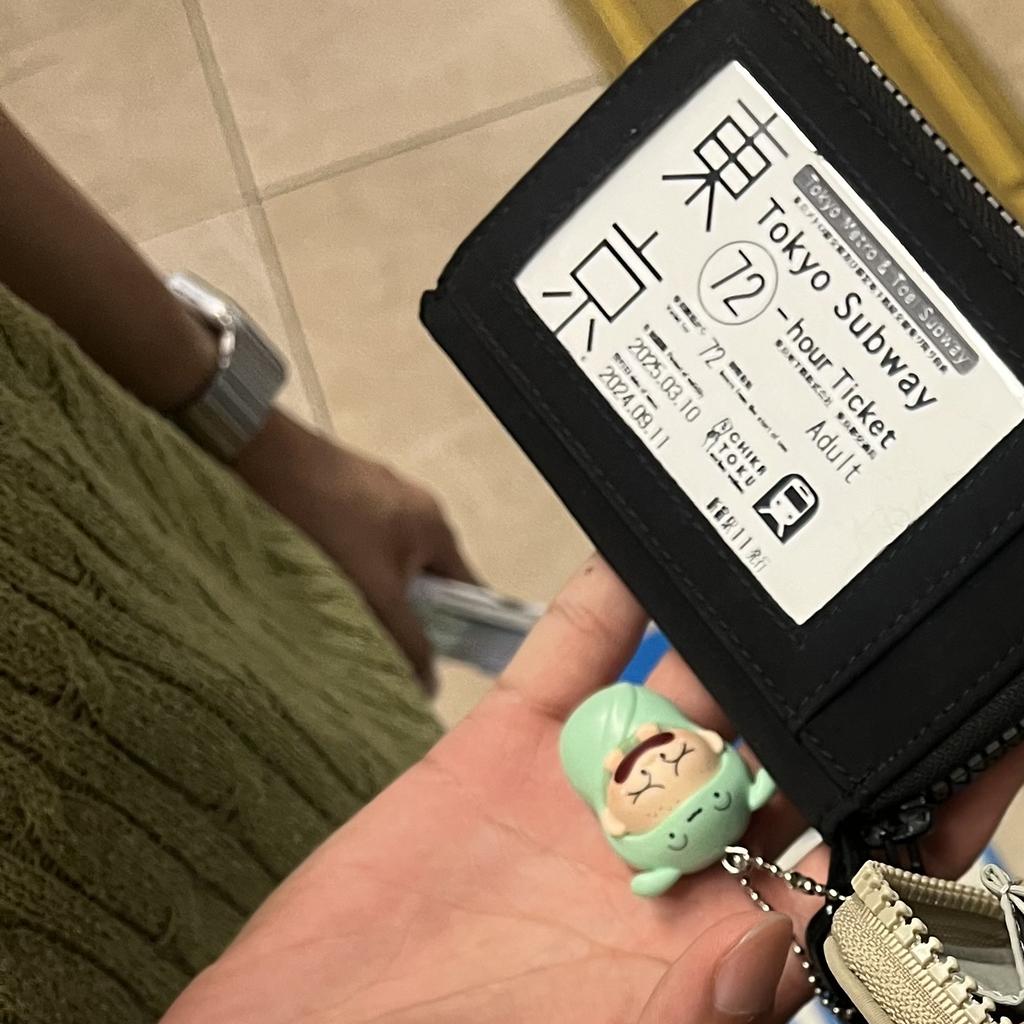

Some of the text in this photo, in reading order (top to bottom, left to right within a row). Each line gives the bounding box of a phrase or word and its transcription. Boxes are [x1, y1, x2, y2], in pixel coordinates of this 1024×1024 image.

[542, 99, 788, 352] 東京
[757, 196, 831, 291] Tokyo
[833, 292, 938, 411] Subway
[806, 173, 841, 219] Tokyo
[918, 306, 970, 365] Subway
[627, 337, 701, 423] 2025.03.10
[698, 337, 726, 369] 72
[710, 249, 766, 317] 72
[832, 367, 896, 450] Ticket
[597, 365, 670, 449] 2024.09.11
[719, 442, 756, 487] TOKU
[729, 431, 767, 476] CHIKA
[805, 420, 862, 484] Adult
